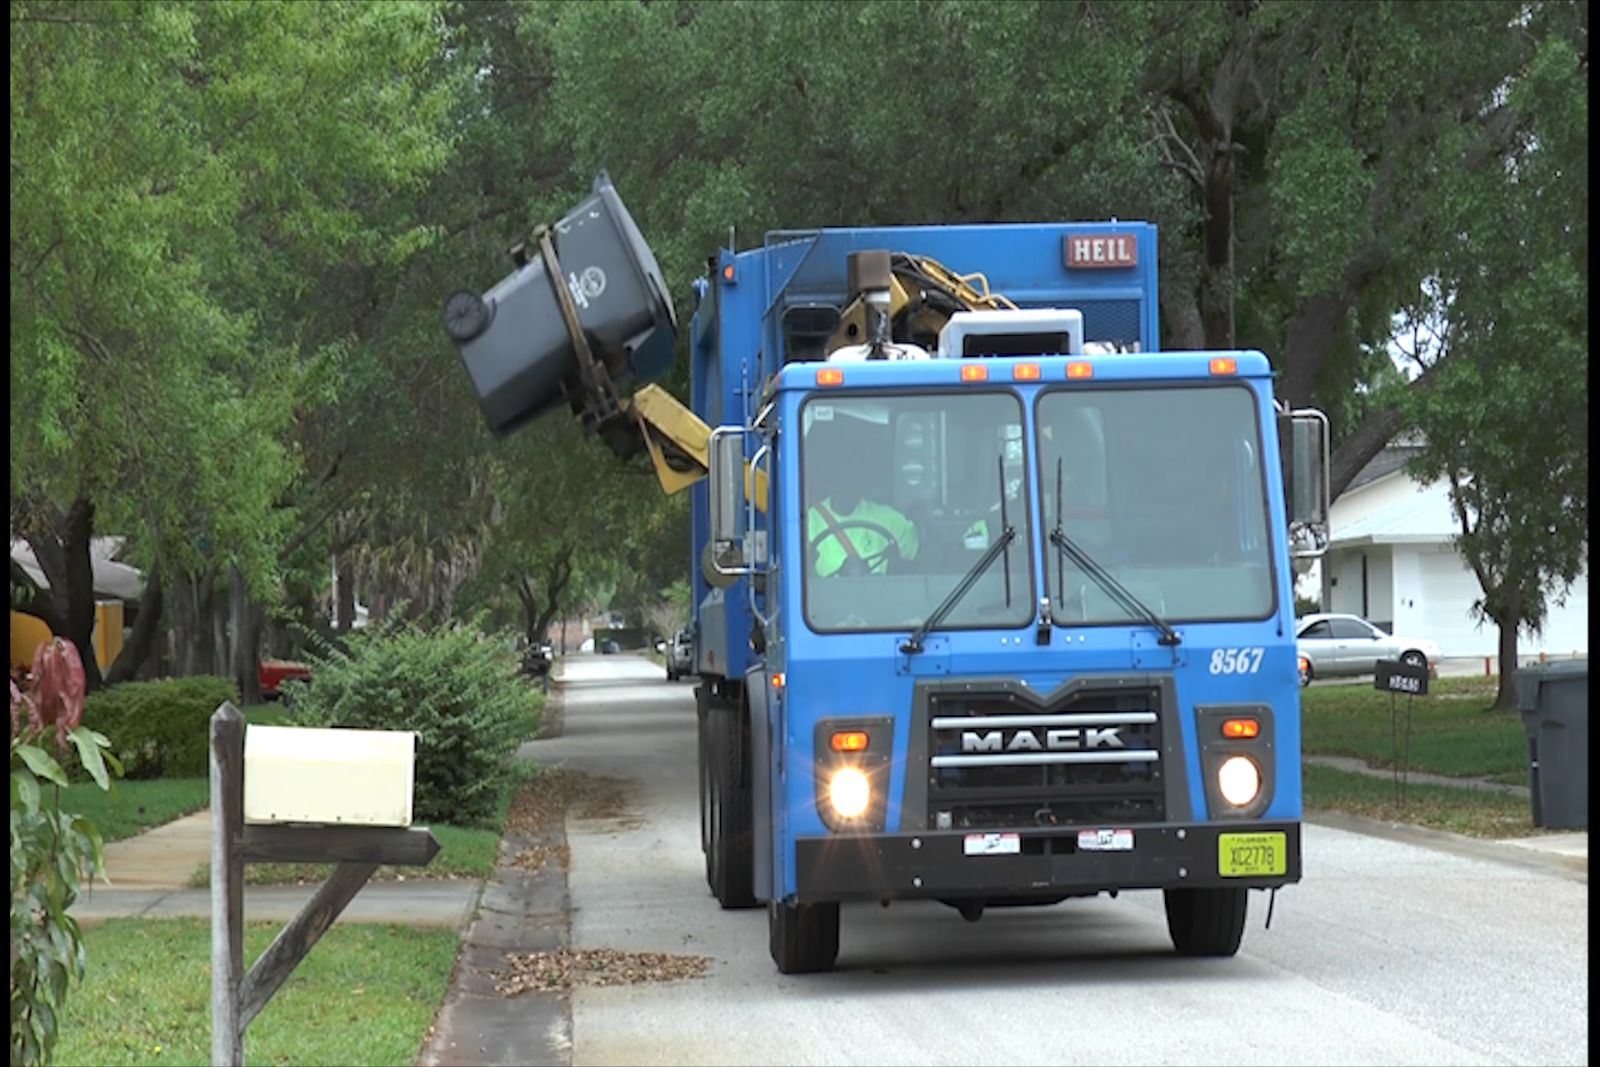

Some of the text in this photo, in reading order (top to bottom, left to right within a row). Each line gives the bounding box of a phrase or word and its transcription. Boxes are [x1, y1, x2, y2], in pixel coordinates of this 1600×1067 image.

[1074, 239, 1130, 261] HEIL
[1209, 647, 1265, 675] 8567
[962, 727, 1125, 751] MACK
